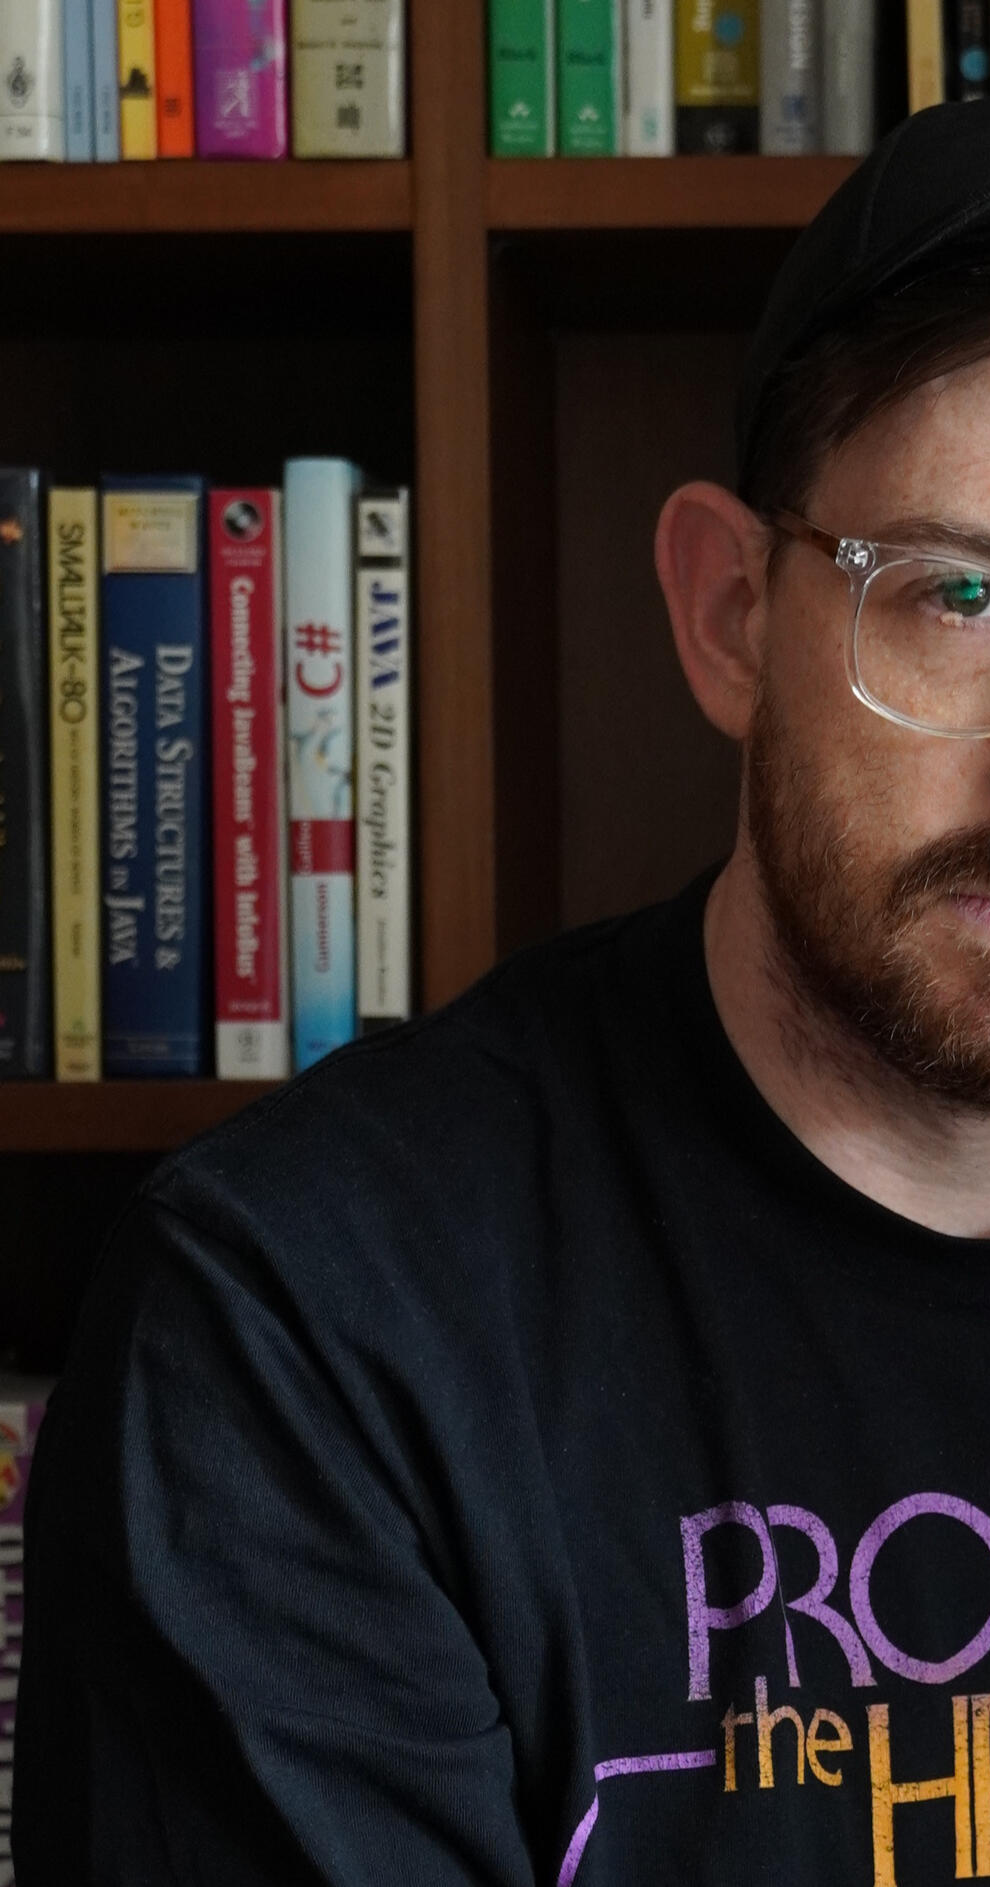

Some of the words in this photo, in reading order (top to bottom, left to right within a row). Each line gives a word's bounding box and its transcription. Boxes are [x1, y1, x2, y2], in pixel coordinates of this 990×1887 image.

[155, 643, 194, 728] DATA
[226, 576, 256, 703] Connecting
[294, 622, 343, 699] C#
[370, 581, 401, 690] JAVA
[108, 648, 144, 859] ALGORITHMS
[369, 702, 396, 750] 2D
[154, 738, 194, 941] STRUCTURES
[233, 836, 258, 886] with
[363, 757, 397, 901] Graphics
[154, 946, 181, 971] &
[719, 1676, 854, 1793] the
